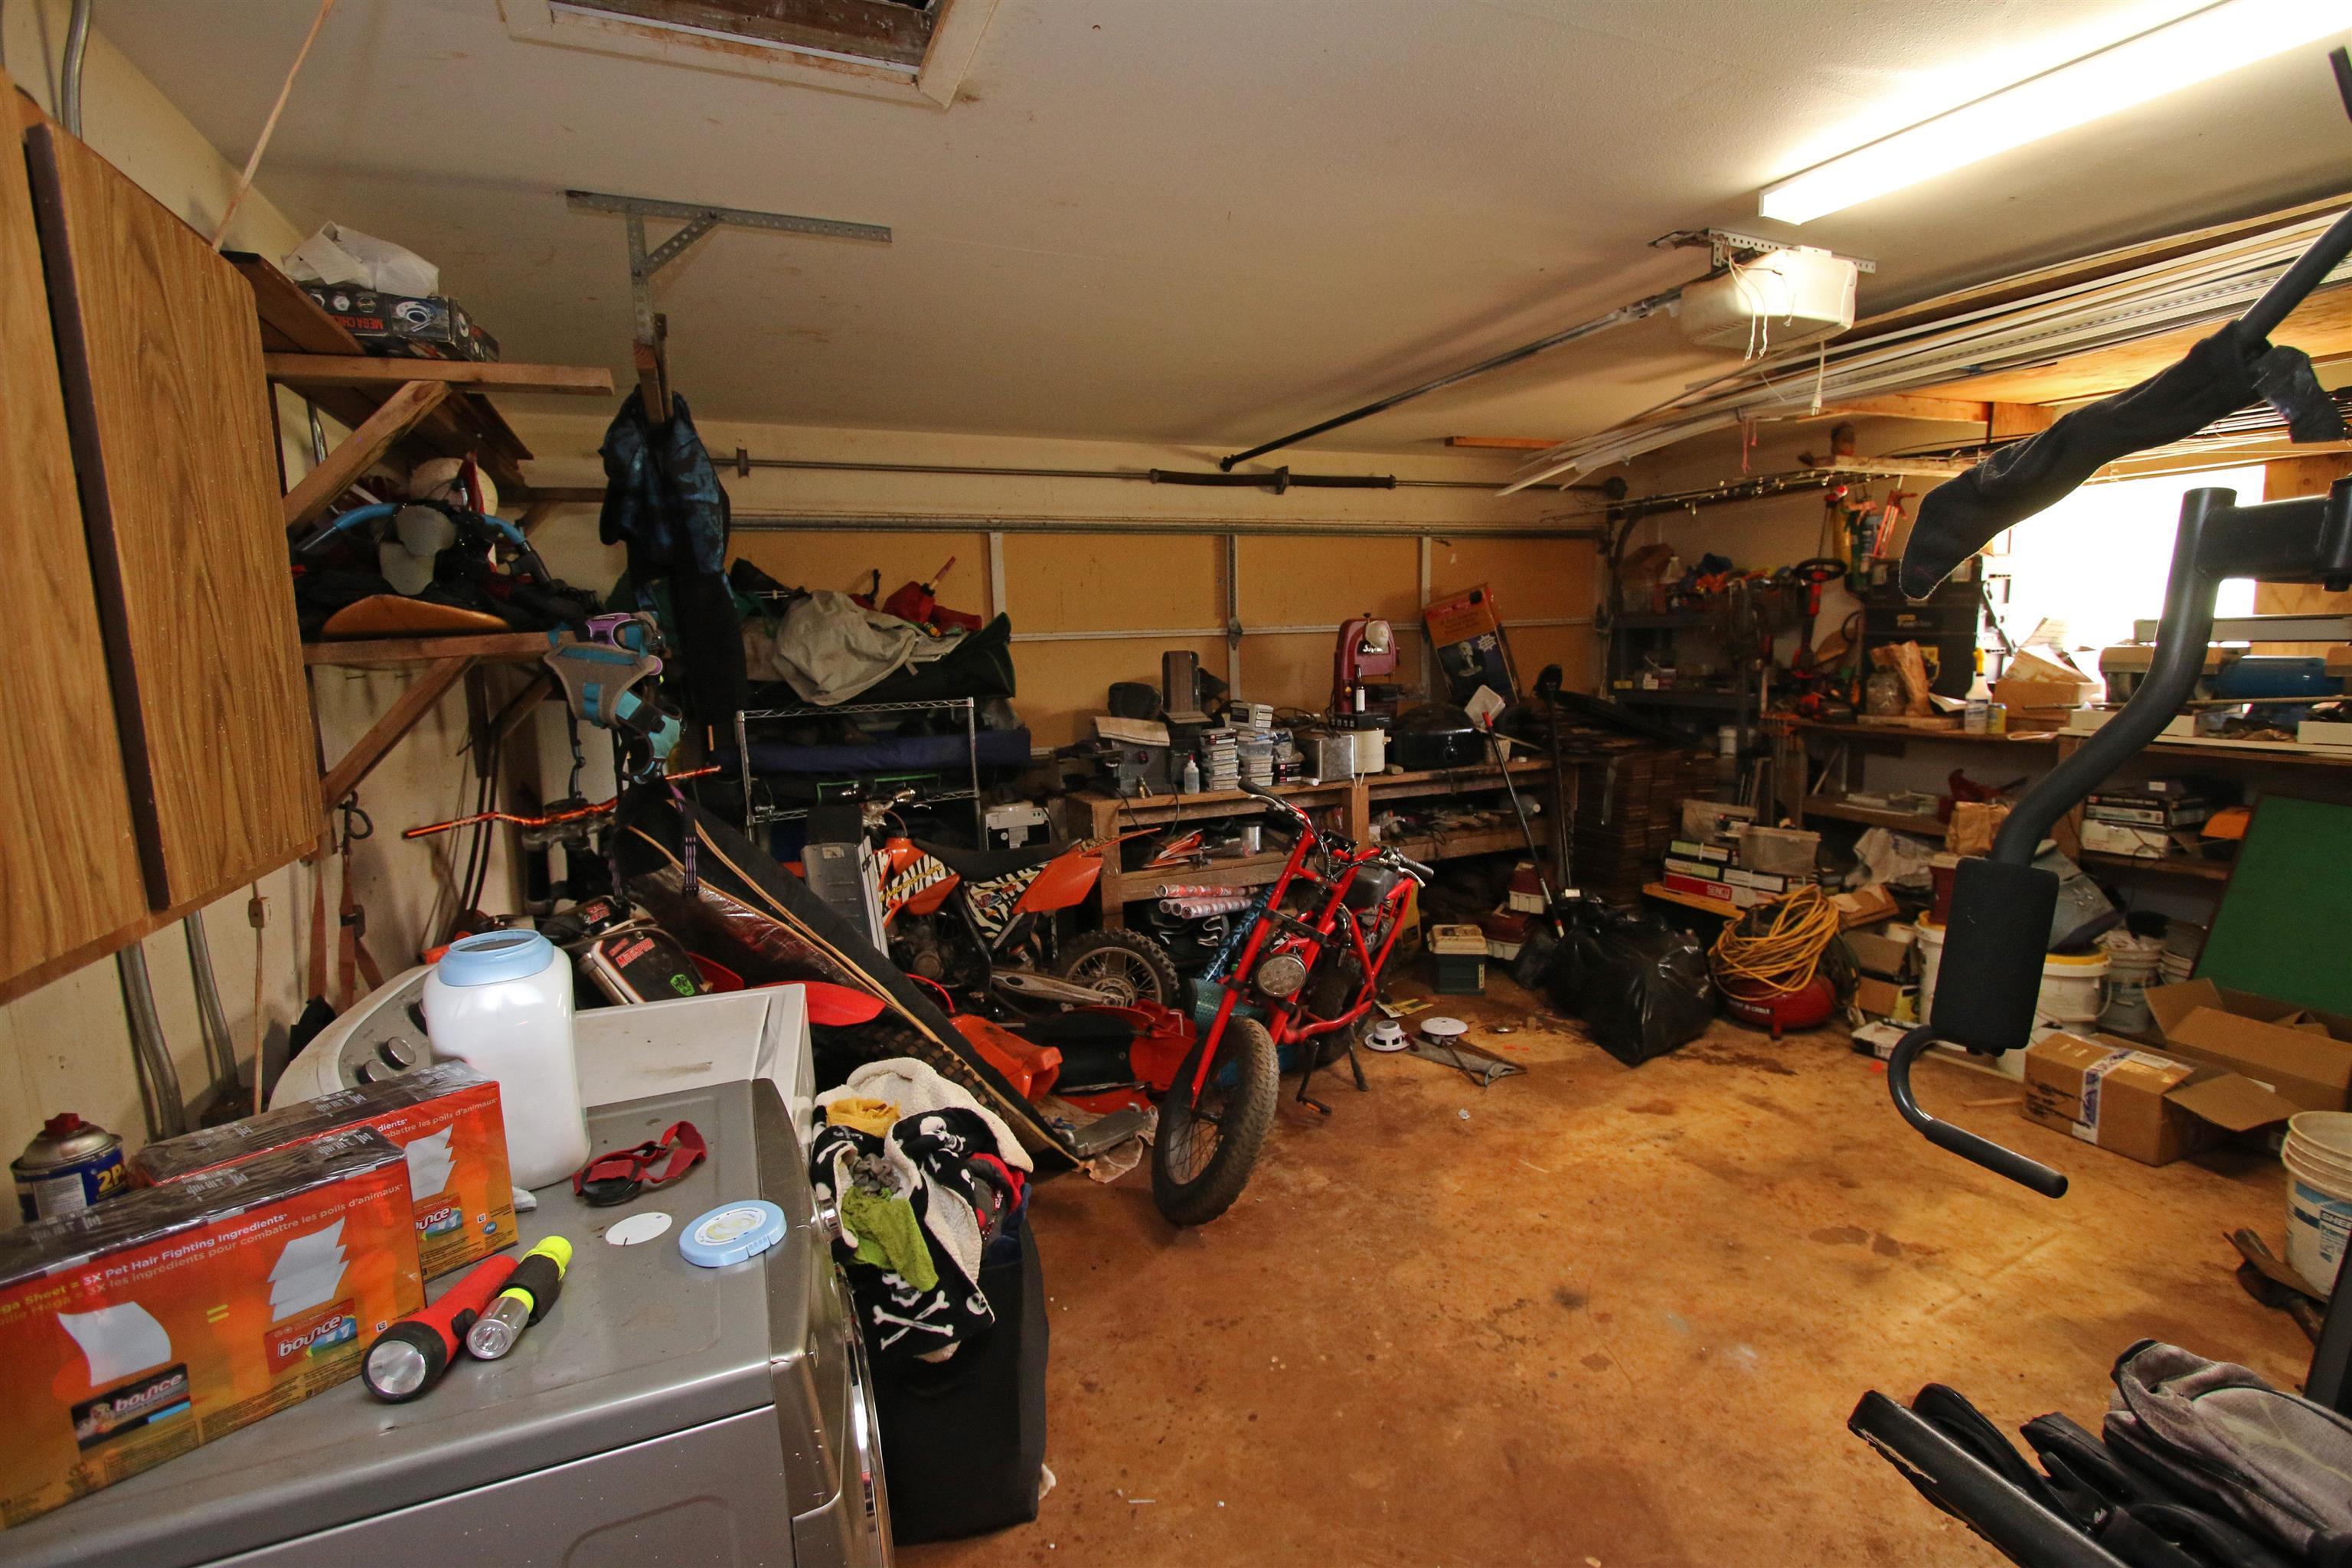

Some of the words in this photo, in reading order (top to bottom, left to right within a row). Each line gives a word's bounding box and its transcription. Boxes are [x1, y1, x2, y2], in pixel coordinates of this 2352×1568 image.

[356, 316, 384, 330] MEGA
[208, 1241, 237, 1258] pour
[240, 1219, 299, 1245] combattre
[302, 1213, 317, 1223] les
[319, 1203, 345, 1218] poils
[83, 1272, 102, 1286] 3X
[106, 1265, 129, 1279] Pet
[132, 1256, 158, 1271] Hair
[162, 1236, 215, 1260] Fighting
[278, 1315, 341, 1358] bounce
[115, 1374, 182, 1413] bounce
